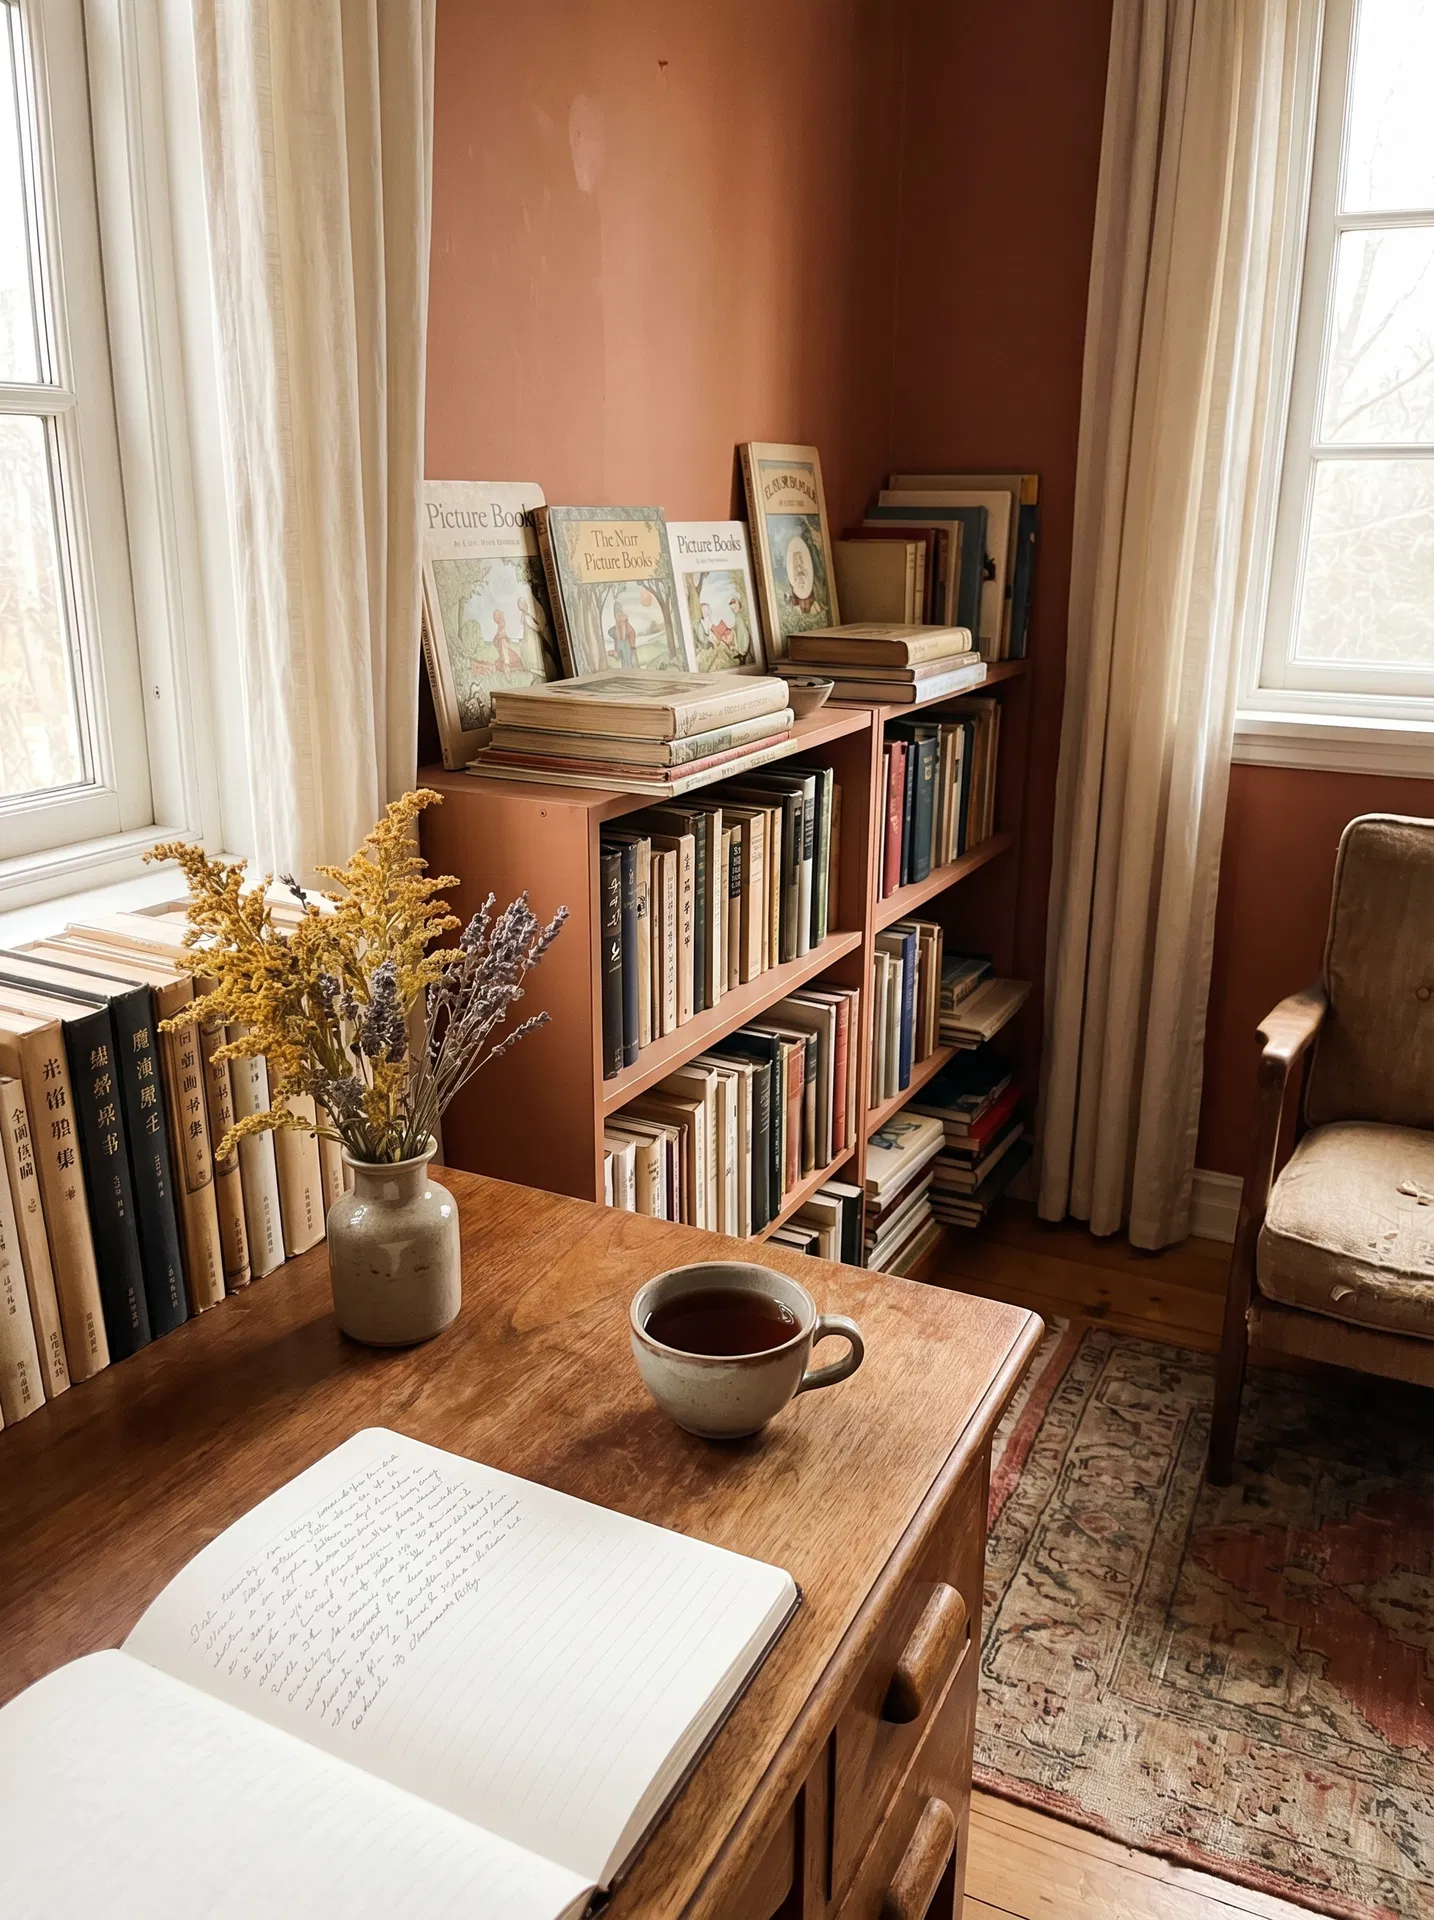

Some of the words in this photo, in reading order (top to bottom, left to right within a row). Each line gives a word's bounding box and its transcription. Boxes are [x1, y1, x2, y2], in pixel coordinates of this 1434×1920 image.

[425, 503, 488, 529] Picture
[591, 530, 613, 547] The
[677, 535, 712, 553] Picture
[712, 534, 742, 552] Books
[584, 553, 621, 570] Picture
[622, 551, 653, 568] Books
